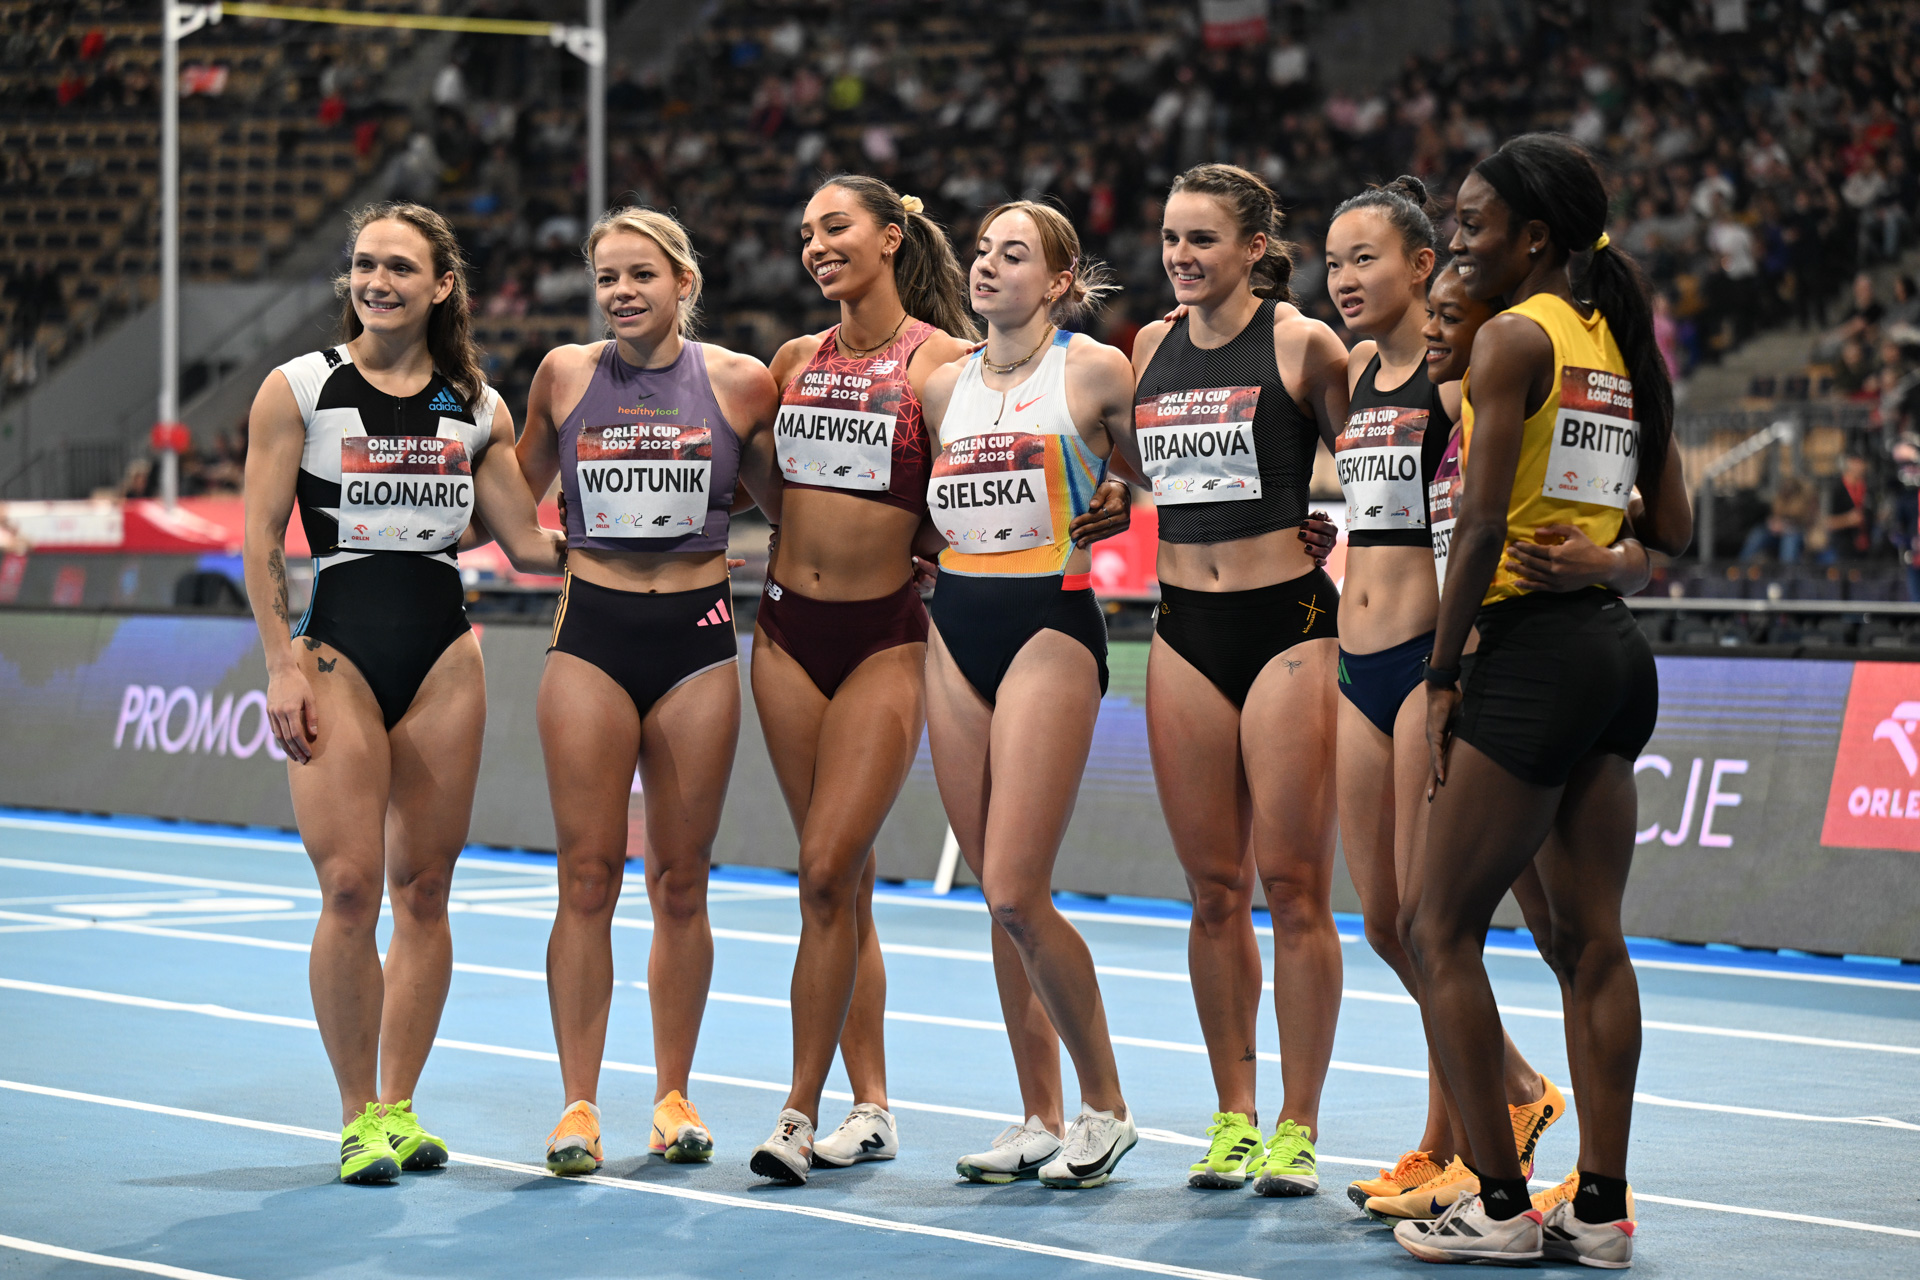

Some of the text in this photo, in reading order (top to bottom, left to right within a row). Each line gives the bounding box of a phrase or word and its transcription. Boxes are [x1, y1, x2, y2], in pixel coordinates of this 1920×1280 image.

[804, 373, 872, 389] ORLEN CUP
[1587, 372, 1632, 394] ORLEN CUP
[801, 384, 869, 402] ŁÓDŹ 2026
[1205, 390, 1231, 402] CUP
[1587, 388, 1633, 408] ŁÓDŹ 2026
[429, 402, 462, 412] adidas
[618, 405, 679, 417] healthyfood
[1157, 403, 1229, 417] ŁÓDŹ 2026
[1377, 410, 1399, 422] CUP
[602, 426, 681, 439] ORLEN CUP
[778, 412, 888, 447] MAJEWSKA
[1367, 425, 1395, 437] 2026
[367, 439, 444, 451] ORLEN CUP
[602, 438, 681, 450] ŁÓDŹ 2026
[951, 435, 1015, 453] ORLEN CUP
[1144, 424, 1250, 462] JIRANOVÁ
[369, 451, 446, 464] ŁÓDŹ 2026
[949, 450, 1015, 466] ŁÓDŹ 2026
[833, 465, 852, 477] 4F
[582, 467, 705, 493] WOJTUNIK
[1202, 479, 1221, 490] 4F
[936, 478, 1036, 509] SIELSKA
[1558, 483, 1579, 491] ORLEN
[347, 480, 469, 508] GLOJNARIC
[1365, 505, 1383, 517] 4F
[652, 515, 671, 526] 4F
[416, 529, 436, 540] 4F
[994, 528, 1012, 540] 4F
[1520, 1104, 1553, 1167] NITRO
